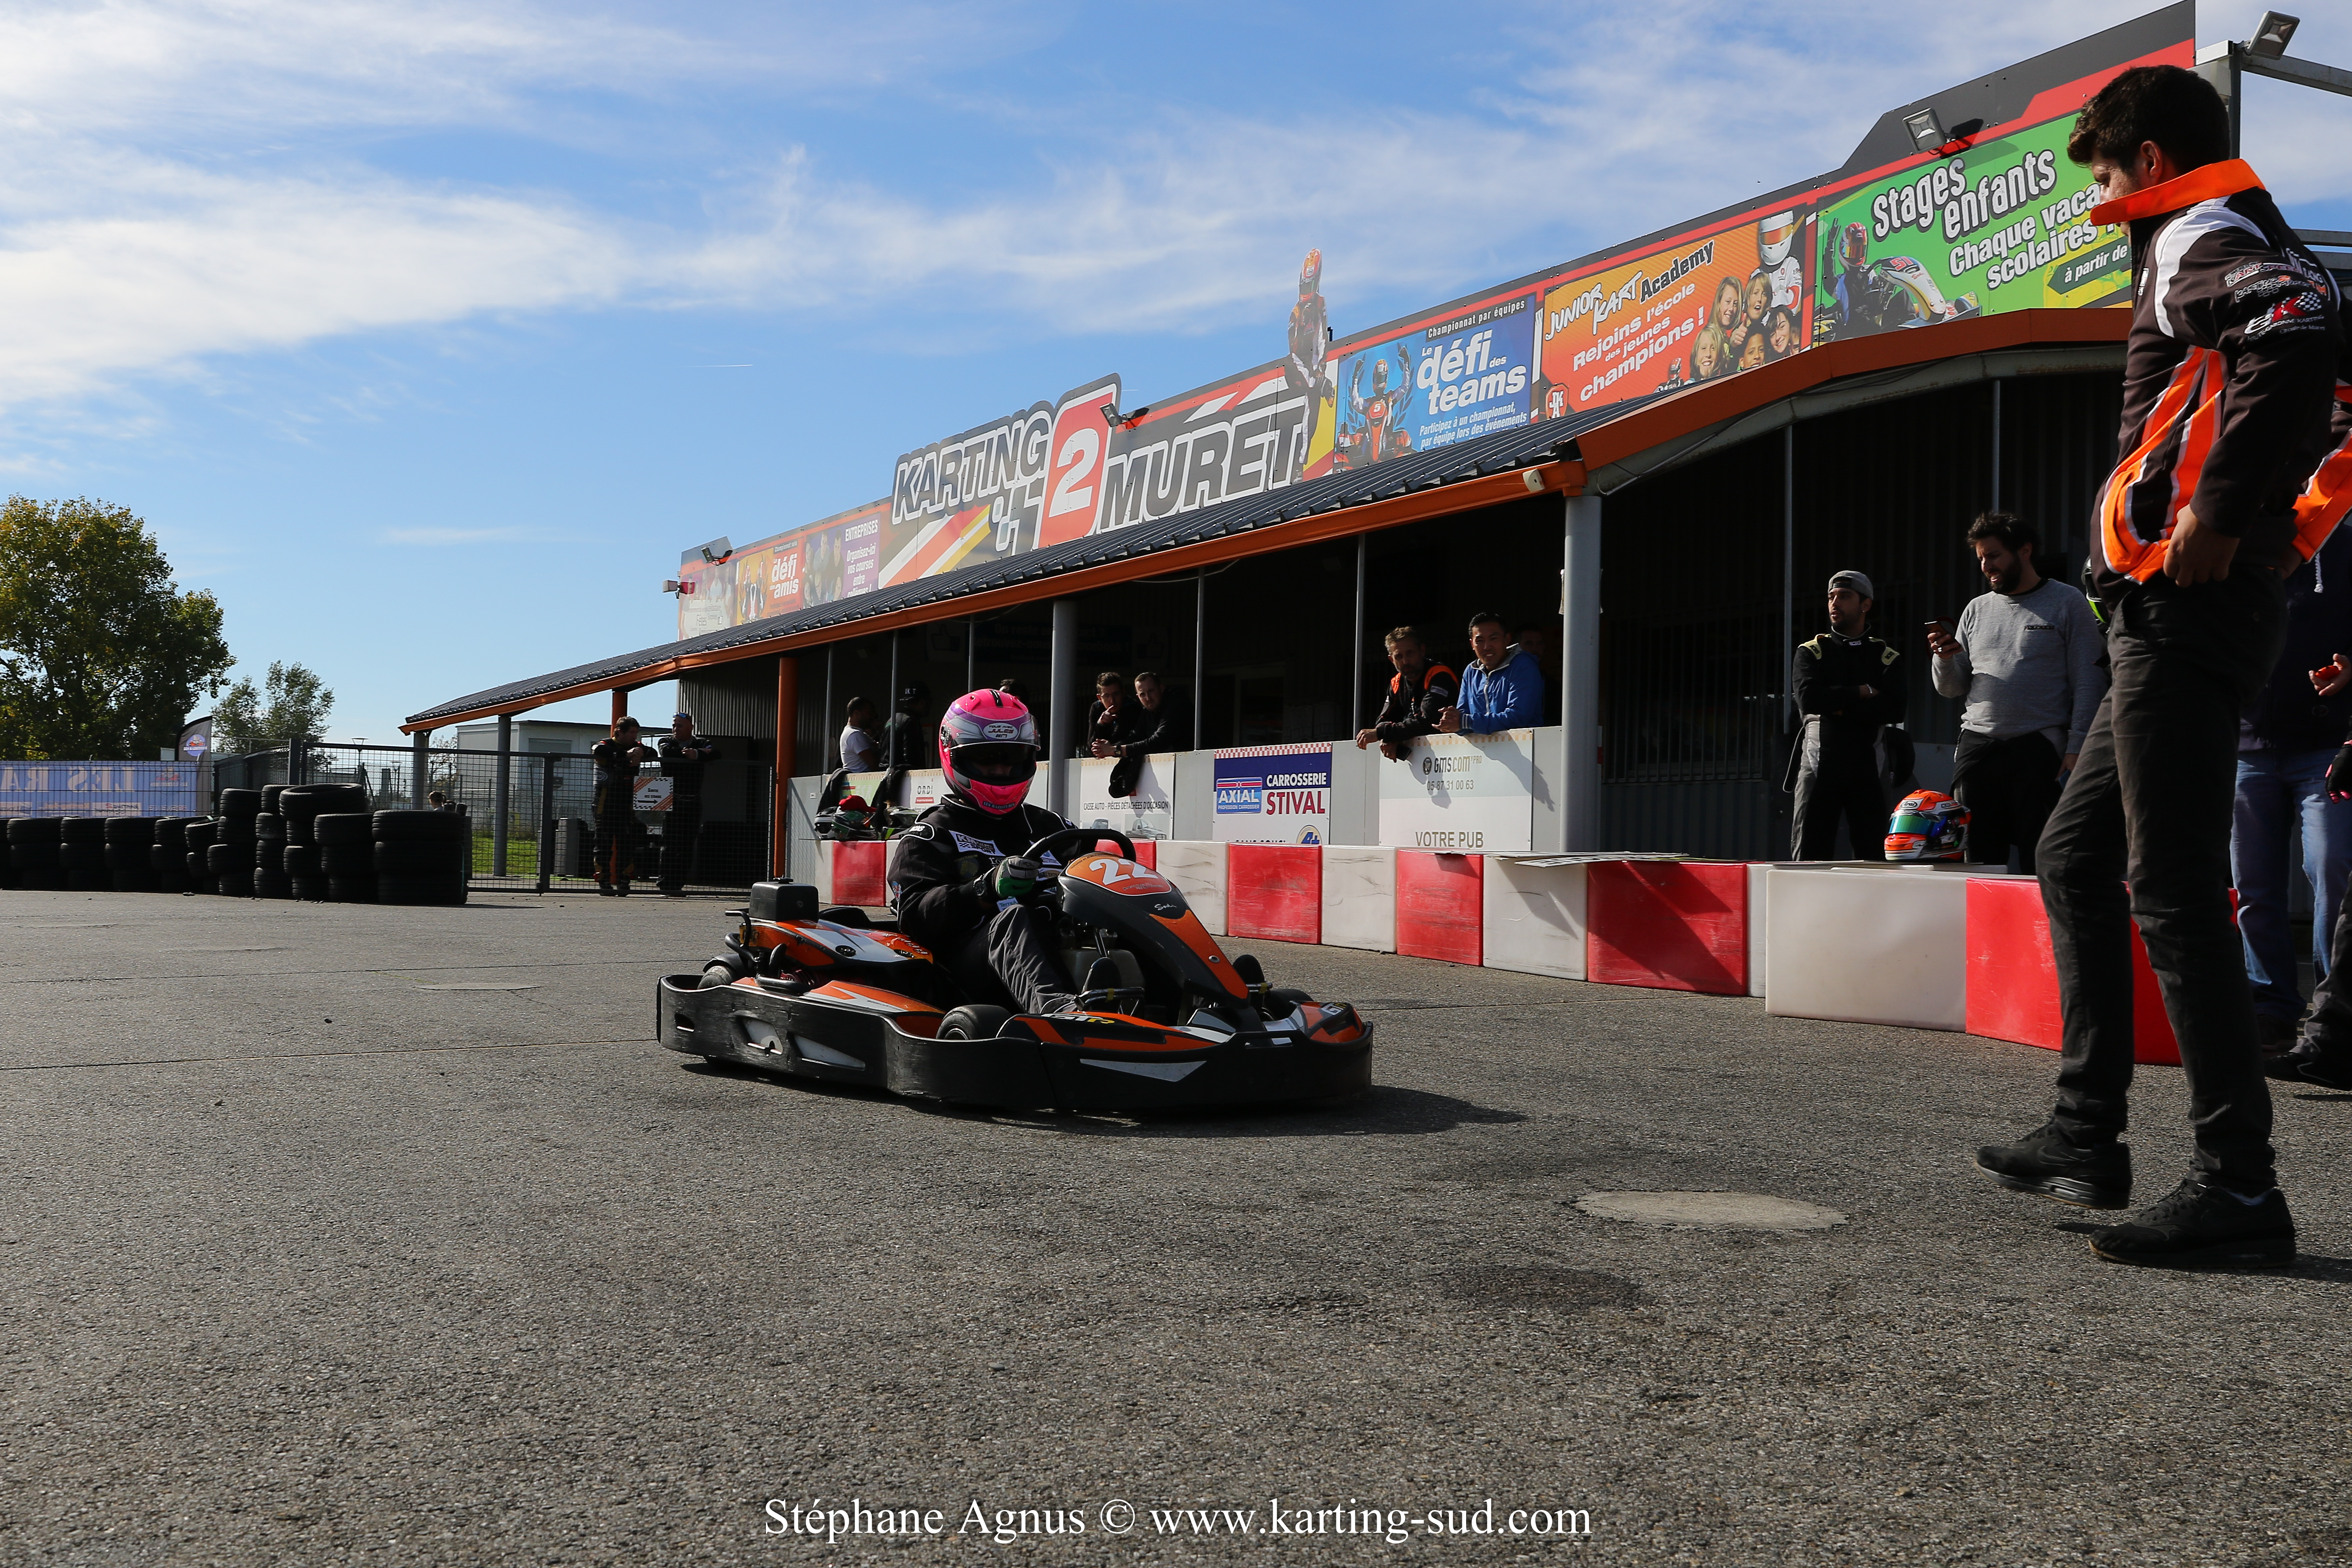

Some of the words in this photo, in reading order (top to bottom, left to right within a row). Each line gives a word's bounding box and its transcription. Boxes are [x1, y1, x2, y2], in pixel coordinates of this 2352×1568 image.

[1872, 159, 1966, 239] Stages
[1944, 150, 2056, 241] enfants
[1950, 216, 2037, 276] Chaque
[1987, 217, 2098, 290] scolaires
[2064, 267, 2072, 283] à
[2075, 251, 2111, 281] partir
[2111, 243, 2127, 263] de
[1592, 271, 1643, 334] KART
[1639, 239, 1714, 304] Academy
[1427, 317, 1476, 339] Championnat
[1479, 310, 1491, 328] par
[1493, 300, 1525, 320] équipes
[1545, 282, 1603, 340] JUNIOR
[1573, 316, 1642, 371] Rejoins
[1647, 283, 1695, 322] l'école
[1421, 346, 1433, 357] Le
[1580, 318, 1694, 401] champions
[1698, 306, 1705, 327] !
[1605, 346, 1621, 361] des
[1622, 316, 1671, 358] jeunes
[1417, 329, 1493, 390] défi
[1489, 355, 1507, 368] des
[1428, 365, 1527, 415] teams
[1419, 419, 1452, 436] Participez
[1453, 416, 1458, 428] à
[1459, 414, 1469, 425] un
[1469, 401, 1516, 423] championnat,
[1420, 438, 1432, 450] par
[1433, 429, 1455, 446] équipe
[1456, 427, 1470, 439] lors
[1471, 422, 1484, 436] des
[1485, 411, 1528, 432] événements
[892, 410, 1052, 525] KARTING
[1049, 427, 1100, 518] 2
[1096, 397, 1308, 533] MURET
[845, 519, 879, 542] ENTREPRISES
[771, 553, 798, 583] défi
[848, 564, 856, 575] vos
[856, 559, 874, 573] courses
[853, 573, 866, 586] entre
[773, 575, 799, 599] amis
[1218, 789, 1260, 804] AXIAL
[1266, 772, 1327, 787] CARROSSERIE
[1427, 781, 1435, 791] 05
[1436, 781, 1445, 790] 87
[1446, 780, 1454, 790] 31
[1456, 780, 1464, 790] 00
[1466, 779, 1474, 790] 63
[1094, 802, 1105, 810] AUTO
[1108, 800, 1121, 810] PIÈCES
[1121, 800, 1142, 810] DÉTACHÉES
[1143, 801, 1169, 809] D'OCCASION
[1266, 791, 1326, 815] STIVAL
[1415, 831, 1455, 847] VOTRE
[1459, 831, 1484, 848] PUB
[1089, 858, 1159, 886] 22
